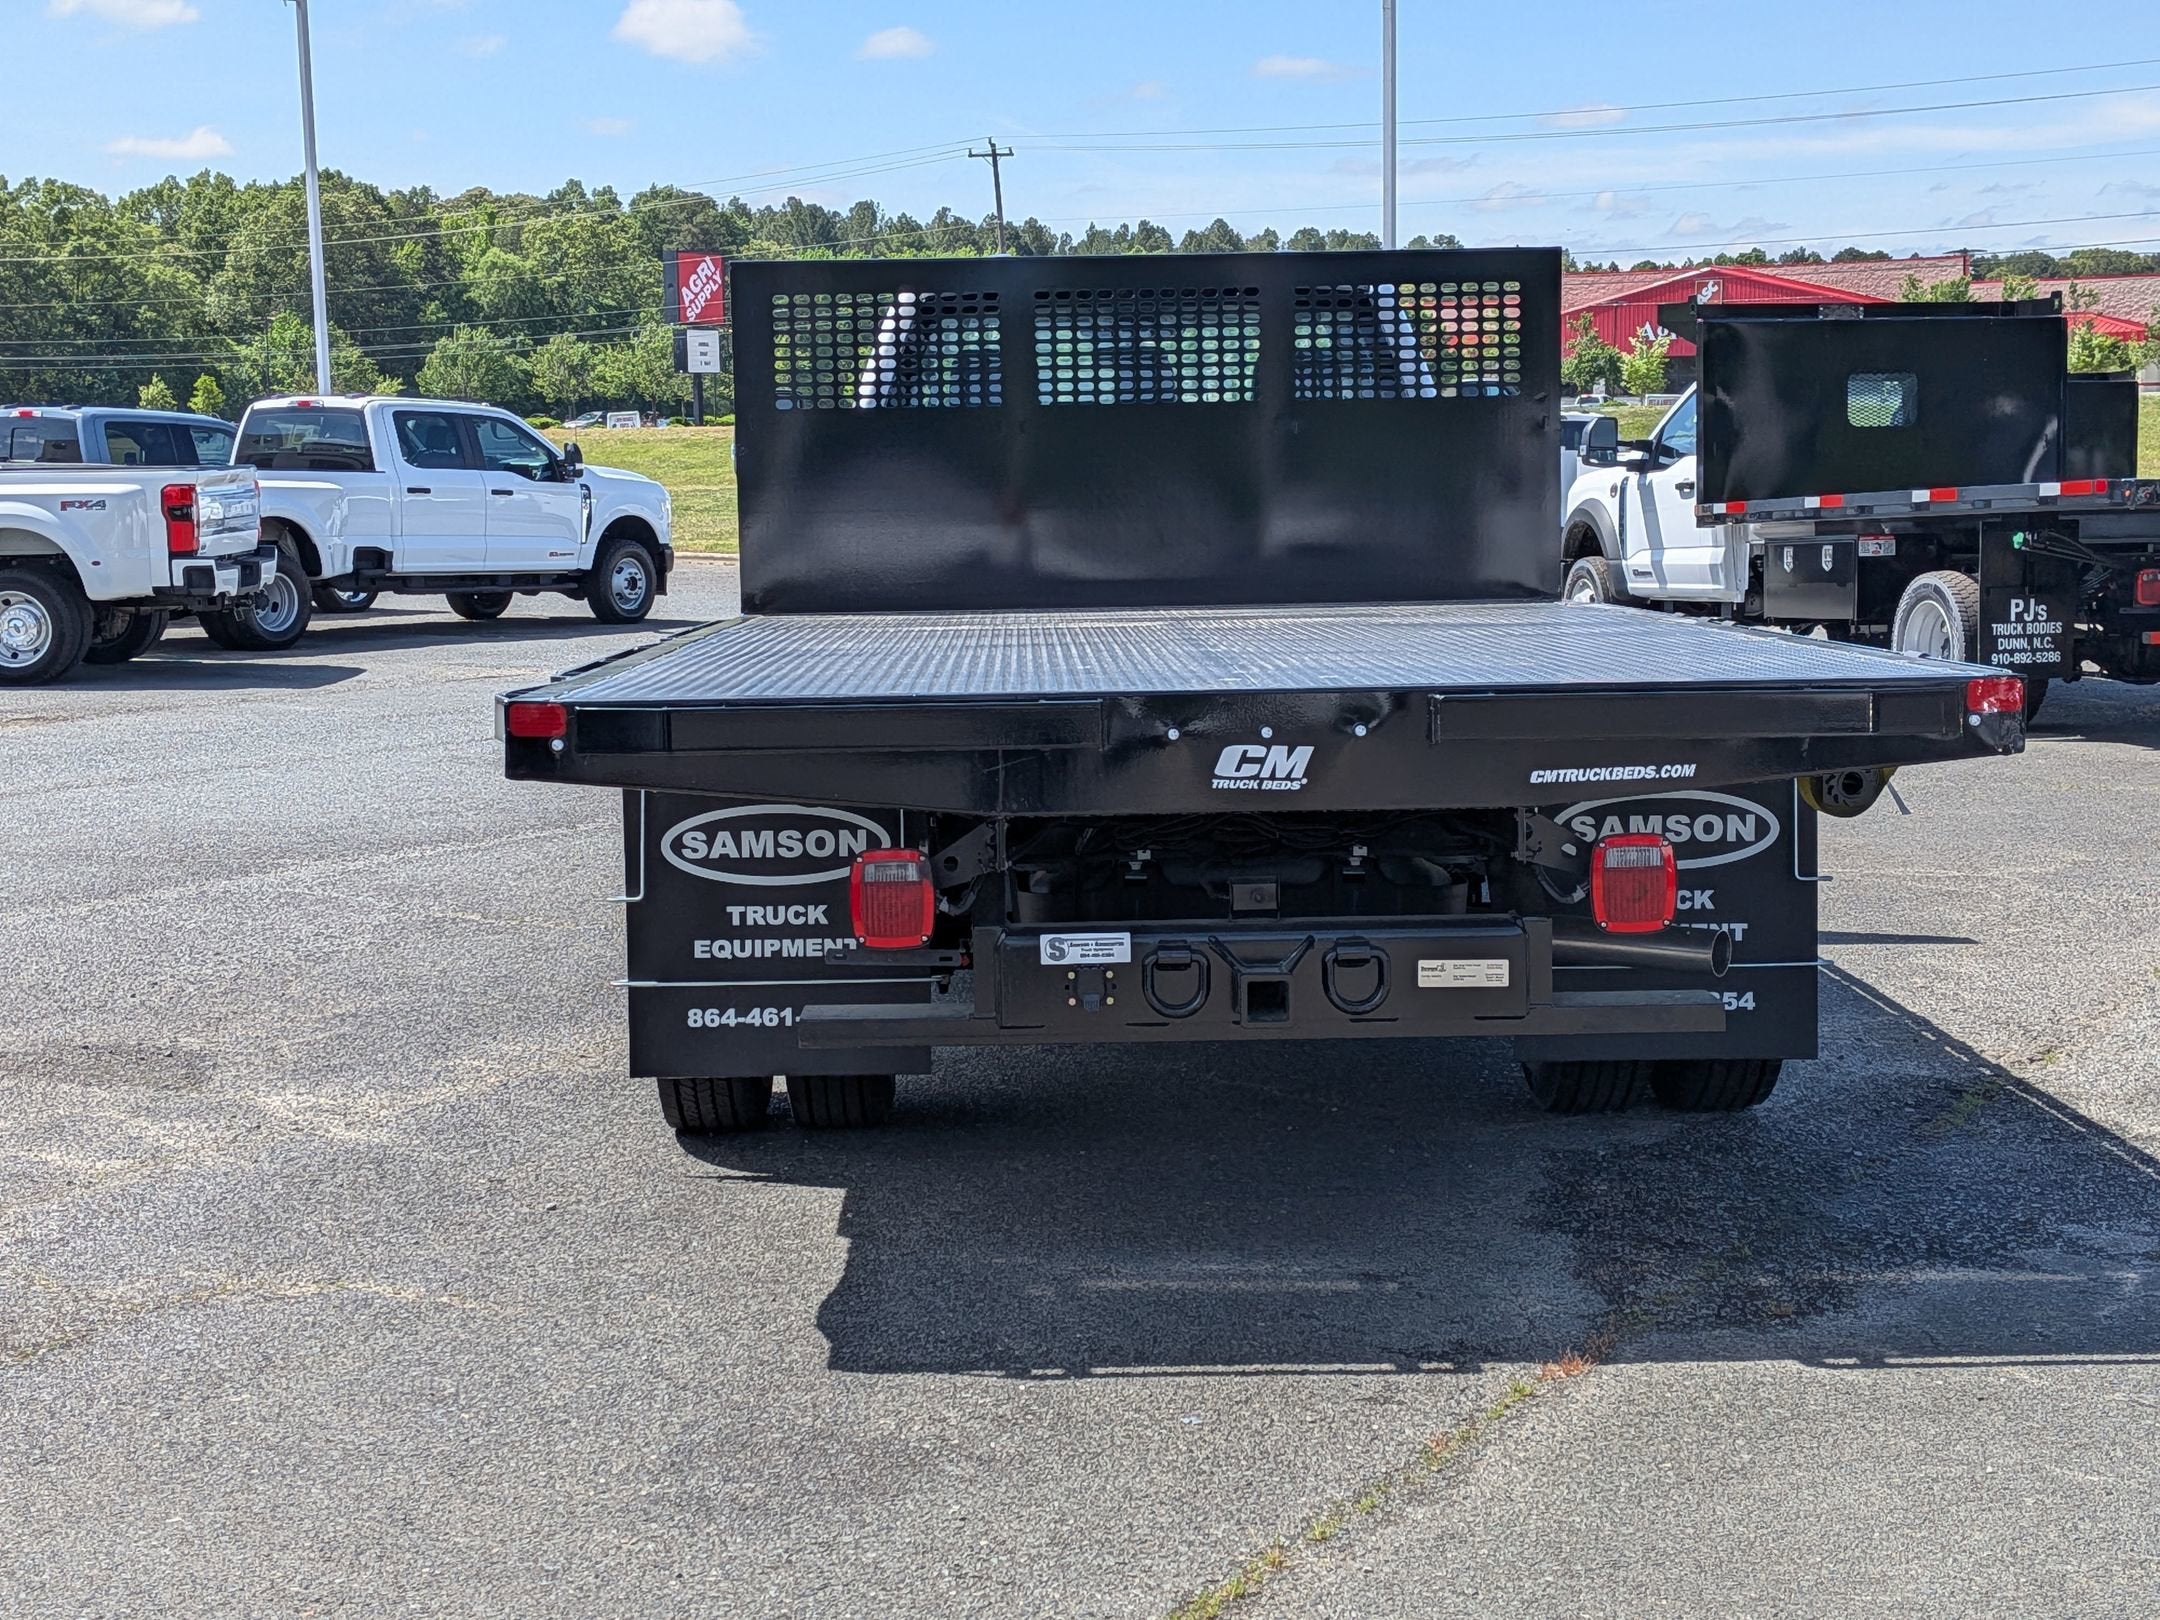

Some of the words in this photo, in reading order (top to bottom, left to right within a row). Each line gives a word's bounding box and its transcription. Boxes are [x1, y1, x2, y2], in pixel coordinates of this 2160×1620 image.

[681, 255, 716, 308] AGRI
[686, 267, 722, 322] SUPPLY
[60, 500, 106, 511] FX4
[1991, 623, 2024, 636] TRUCK
[2026, 622, 2063, 635] BODIES
[1997, 637, 2031, 651] DUNN,
[2033, 636, 2055, 649] N.C.
[1991, 651, 2062, 665] 910-892-5286
[1214, 744, 1315, 779] CM
[1530, 763, 1697, 784] CMTRUCKBEDS.COM
[1211, 778, 1259, 790] TRUCK
[1261, 779, 1302, 791] BEDS
[1570, 814, 1756, 843] SAMSON
[680, 829, 868, 860] SAMSON
[726, 904, 829, 926] TRUCK
[687, 1007, 801, 1028] 864-461-
